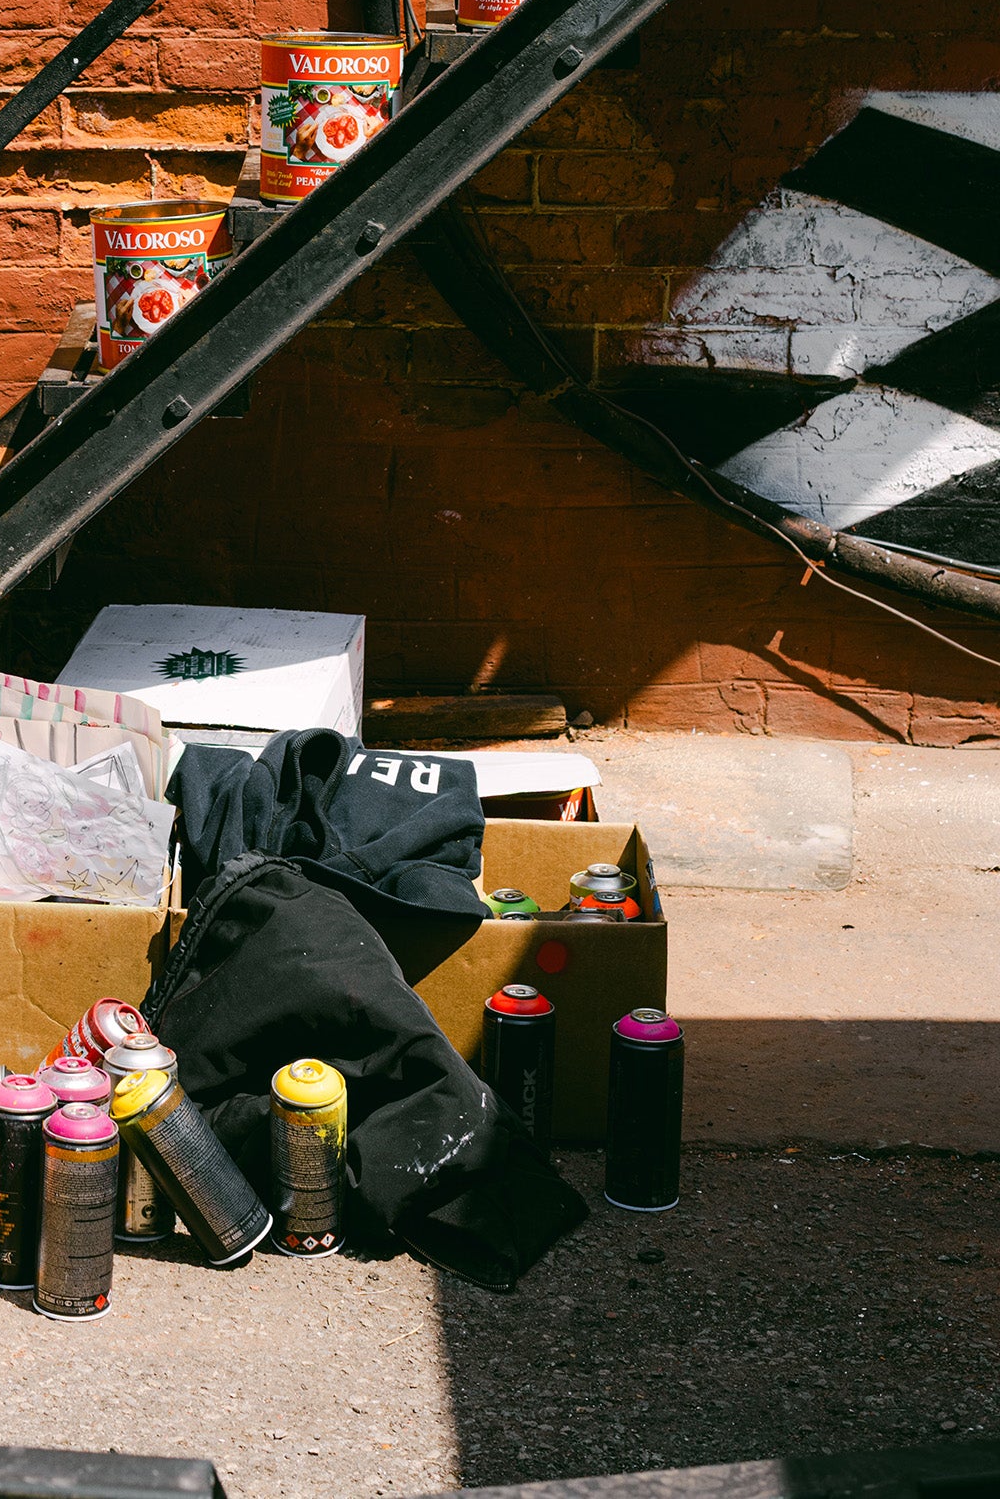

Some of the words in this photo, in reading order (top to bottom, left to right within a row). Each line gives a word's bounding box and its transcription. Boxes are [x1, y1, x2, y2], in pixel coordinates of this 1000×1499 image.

[288, 53, 390, 75] VALOROSO
[296, 176, 321, 187] PEAR
[104, 228, 205, 250] VALOROSO
